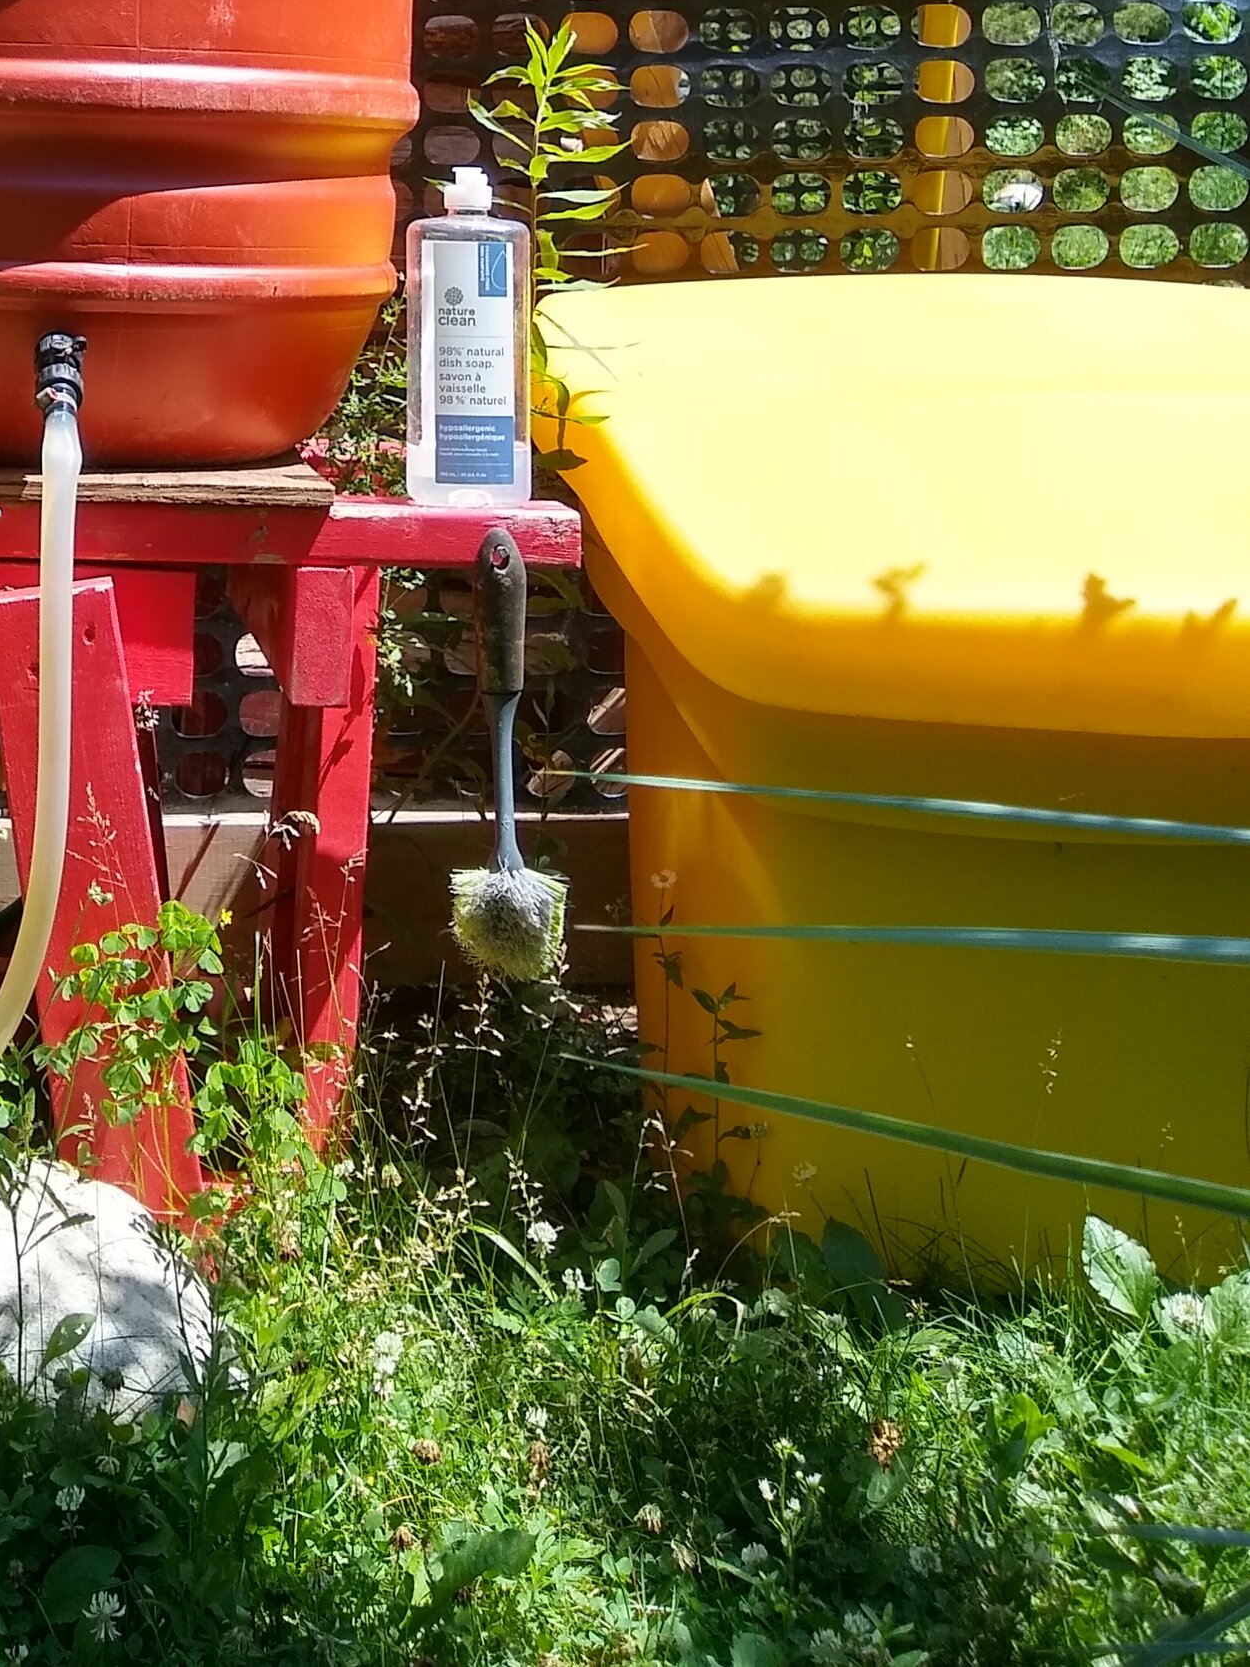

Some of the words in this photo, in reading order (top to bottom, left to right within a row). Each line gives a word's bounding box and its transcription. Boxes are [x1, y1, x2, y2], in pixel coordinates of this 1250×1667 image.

[438, 307, 476, 316] nature
[438, 316, 476, 326] clean
[466, 347, 504, 356] natural
[438, 358, 462, 368] dish
[465, 360, 494, 369] soap.
[438, 373, 472, 381] savon
[474, 372, 482, 382] à
[439, 384, 486, 394] vaisselle
[439, 424, 496, 433] hypoallergenic
[439, 434, 506, 442] hypoallergénique
